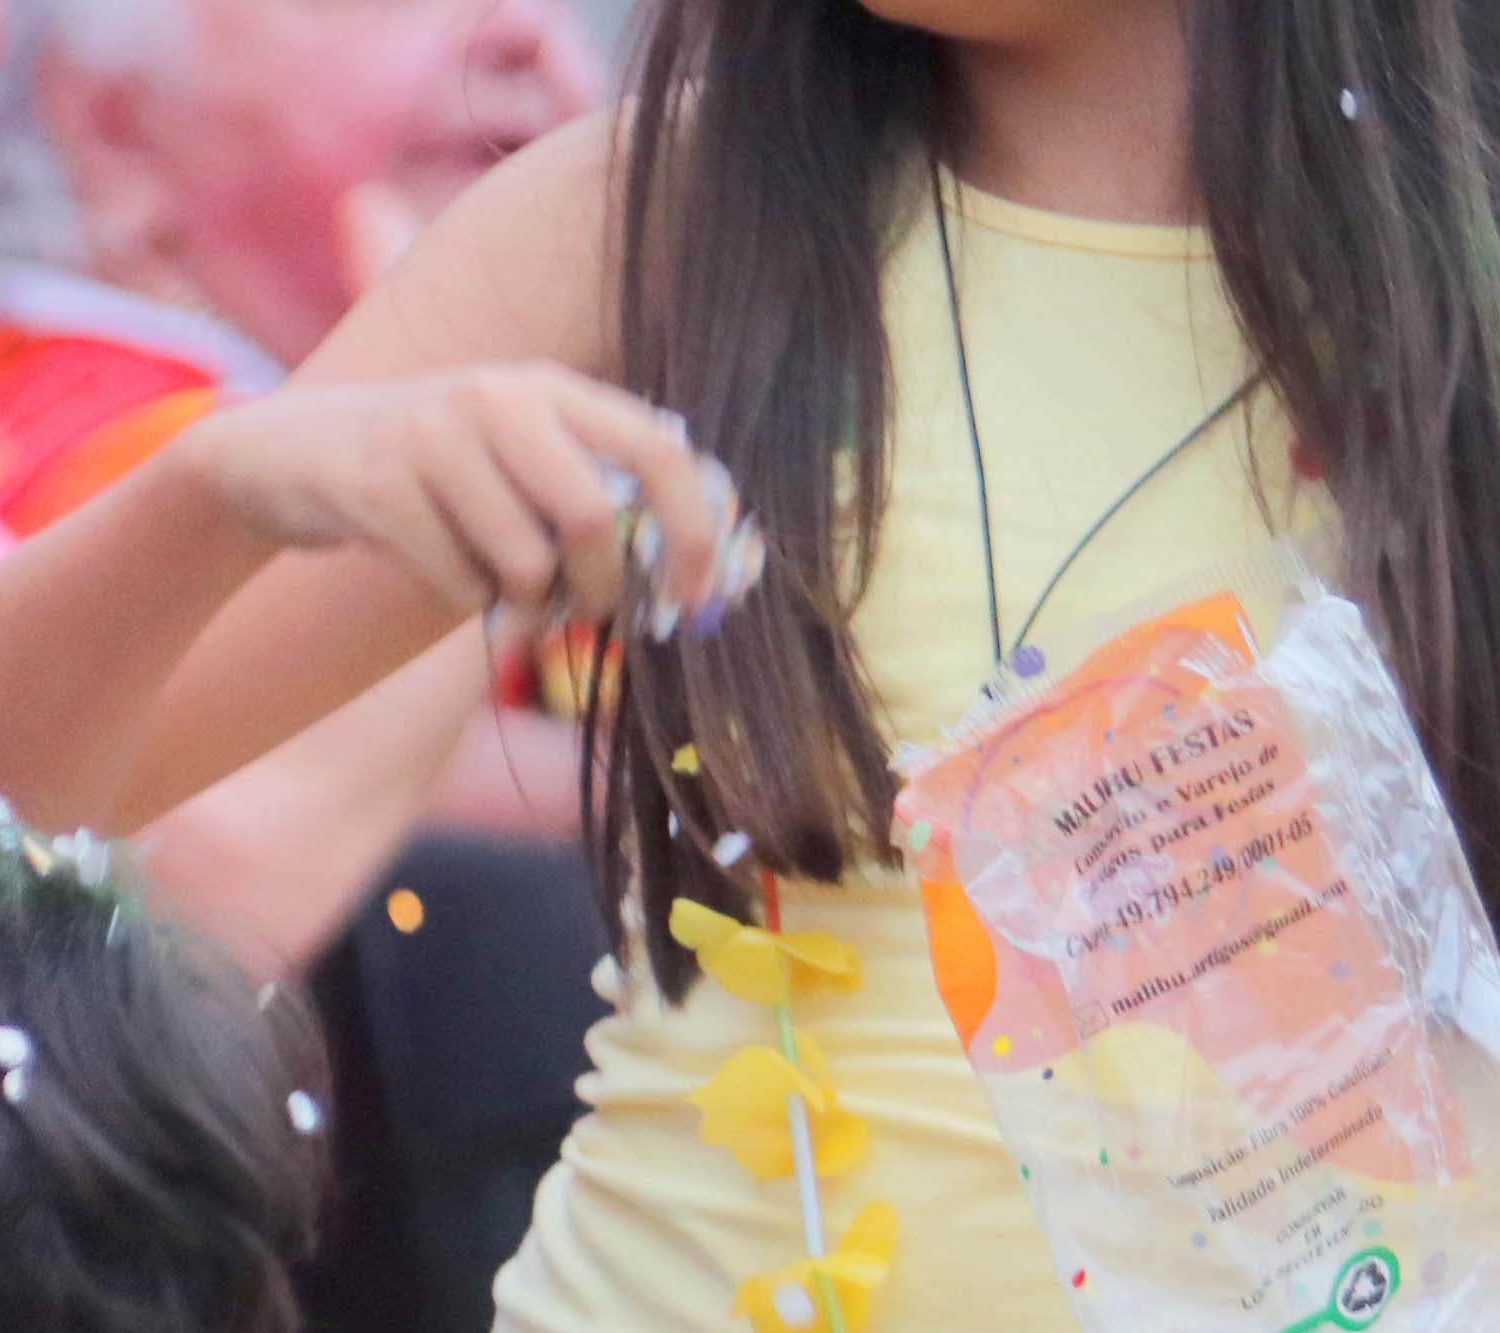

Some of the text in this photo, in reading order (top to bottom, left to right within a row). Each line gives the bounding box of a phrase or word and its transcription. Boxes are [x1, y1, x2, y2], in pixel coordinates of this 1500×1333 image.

[1053, 709, 1255, 838] MALIBU FESTAS
[1175, 761, 1253, 804] Varejo
[1258, 744, 1279, 767] de
[1150, 814, 1209, 855] para
[1211, 779, 1276, 822] Festas
[1116, 812, 1313, 929] 49.794.249/0001-05
[1249, 1119, 1289, 1151] Fibra
